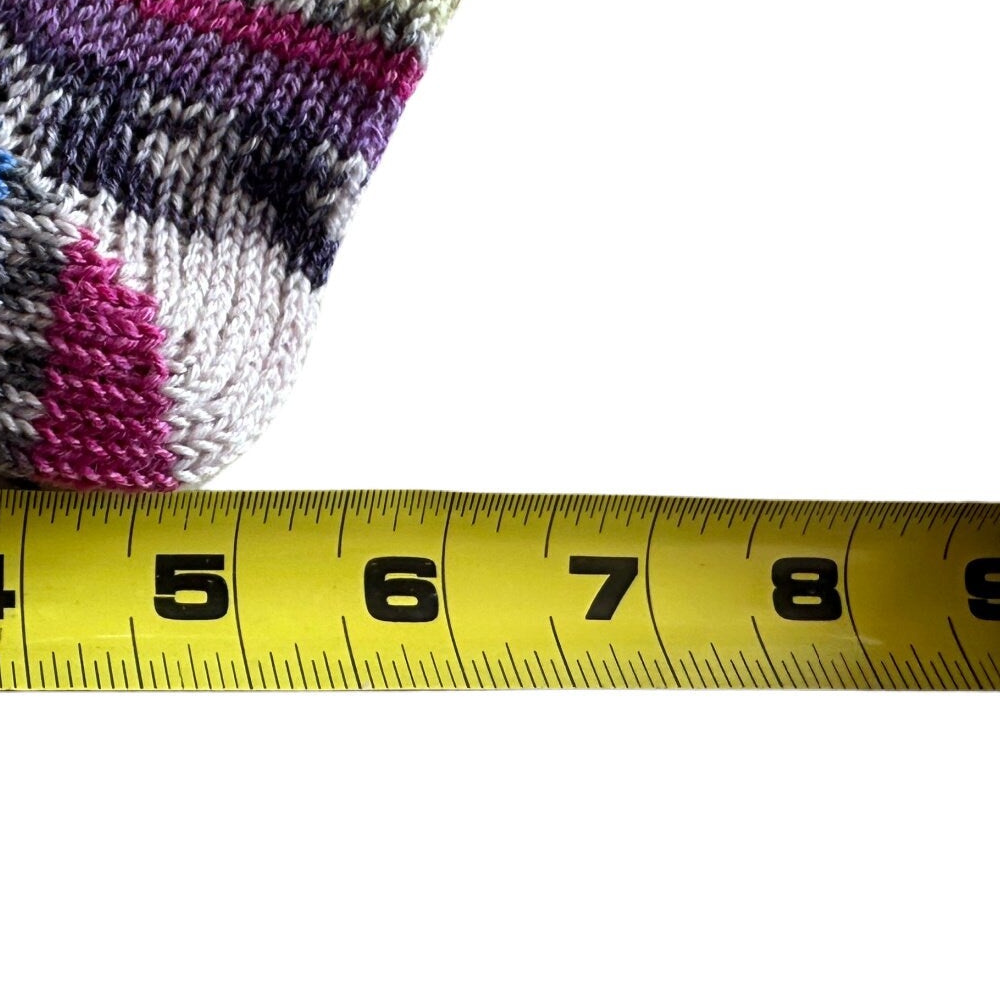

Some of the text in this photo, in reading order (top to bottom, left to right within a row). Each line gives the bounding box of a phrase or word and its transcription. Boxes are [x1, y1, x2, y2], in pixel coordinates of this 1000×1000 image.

[153, 554, 228, 621] 5
[364, 556, 439, 622] 6
[568, 556, 639, 621] 7
[771, 557, 842, 622] 8
